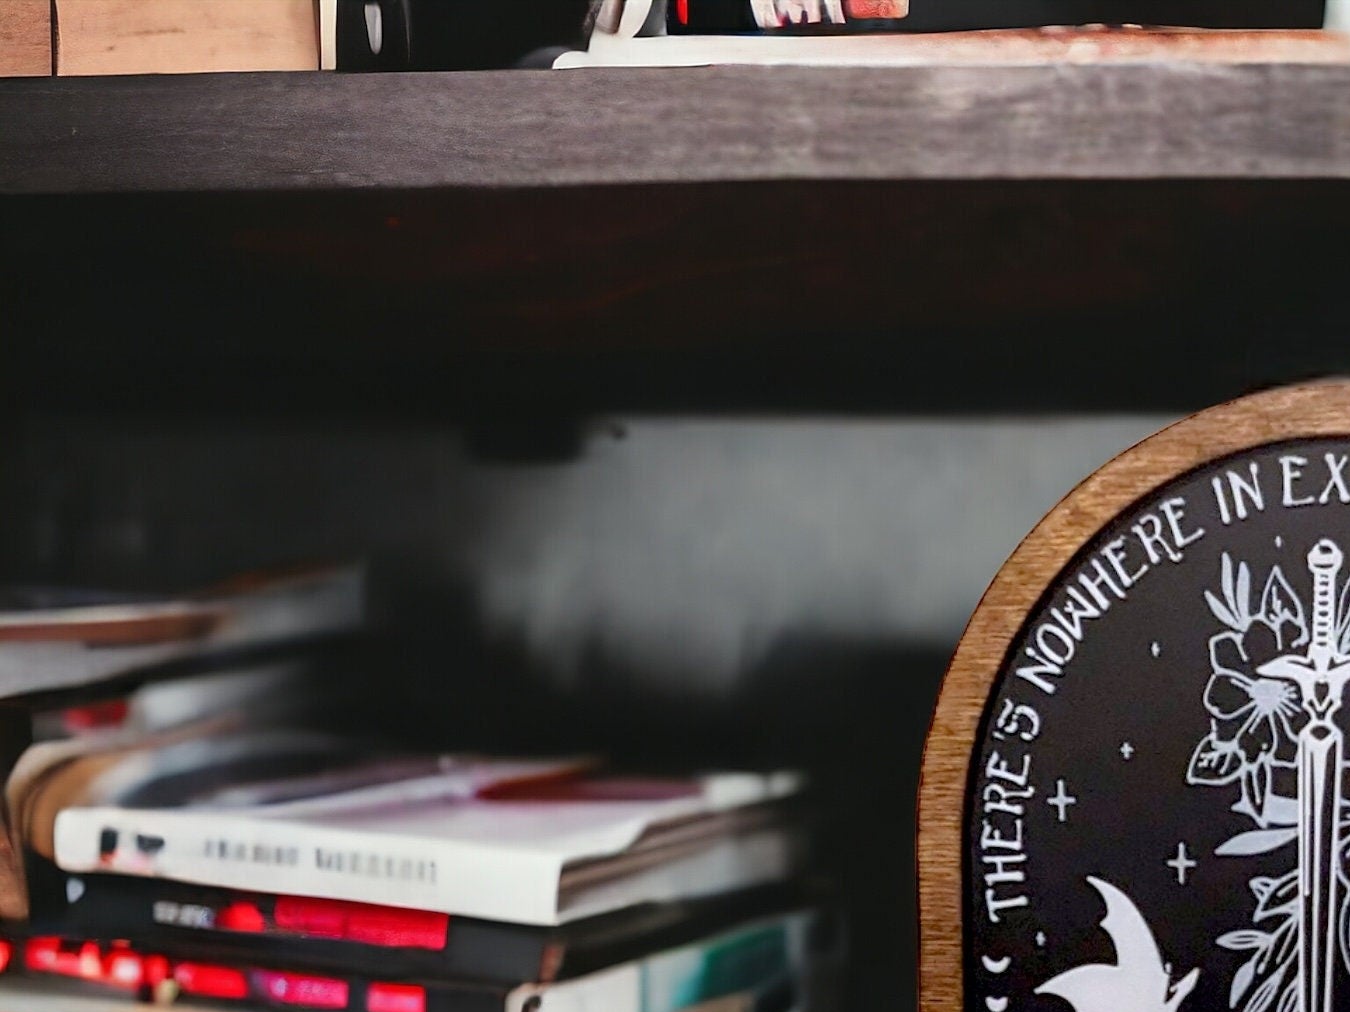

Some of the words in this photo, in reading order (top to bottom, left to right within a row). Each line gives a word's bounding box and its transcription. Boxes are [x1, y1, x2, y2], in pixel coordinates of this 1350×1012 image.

[981, 698, 1040, 923] THERE'S
[1016, 497, 1204, 694] NOWHERE
[1212, 462, 1264, 524] IN
